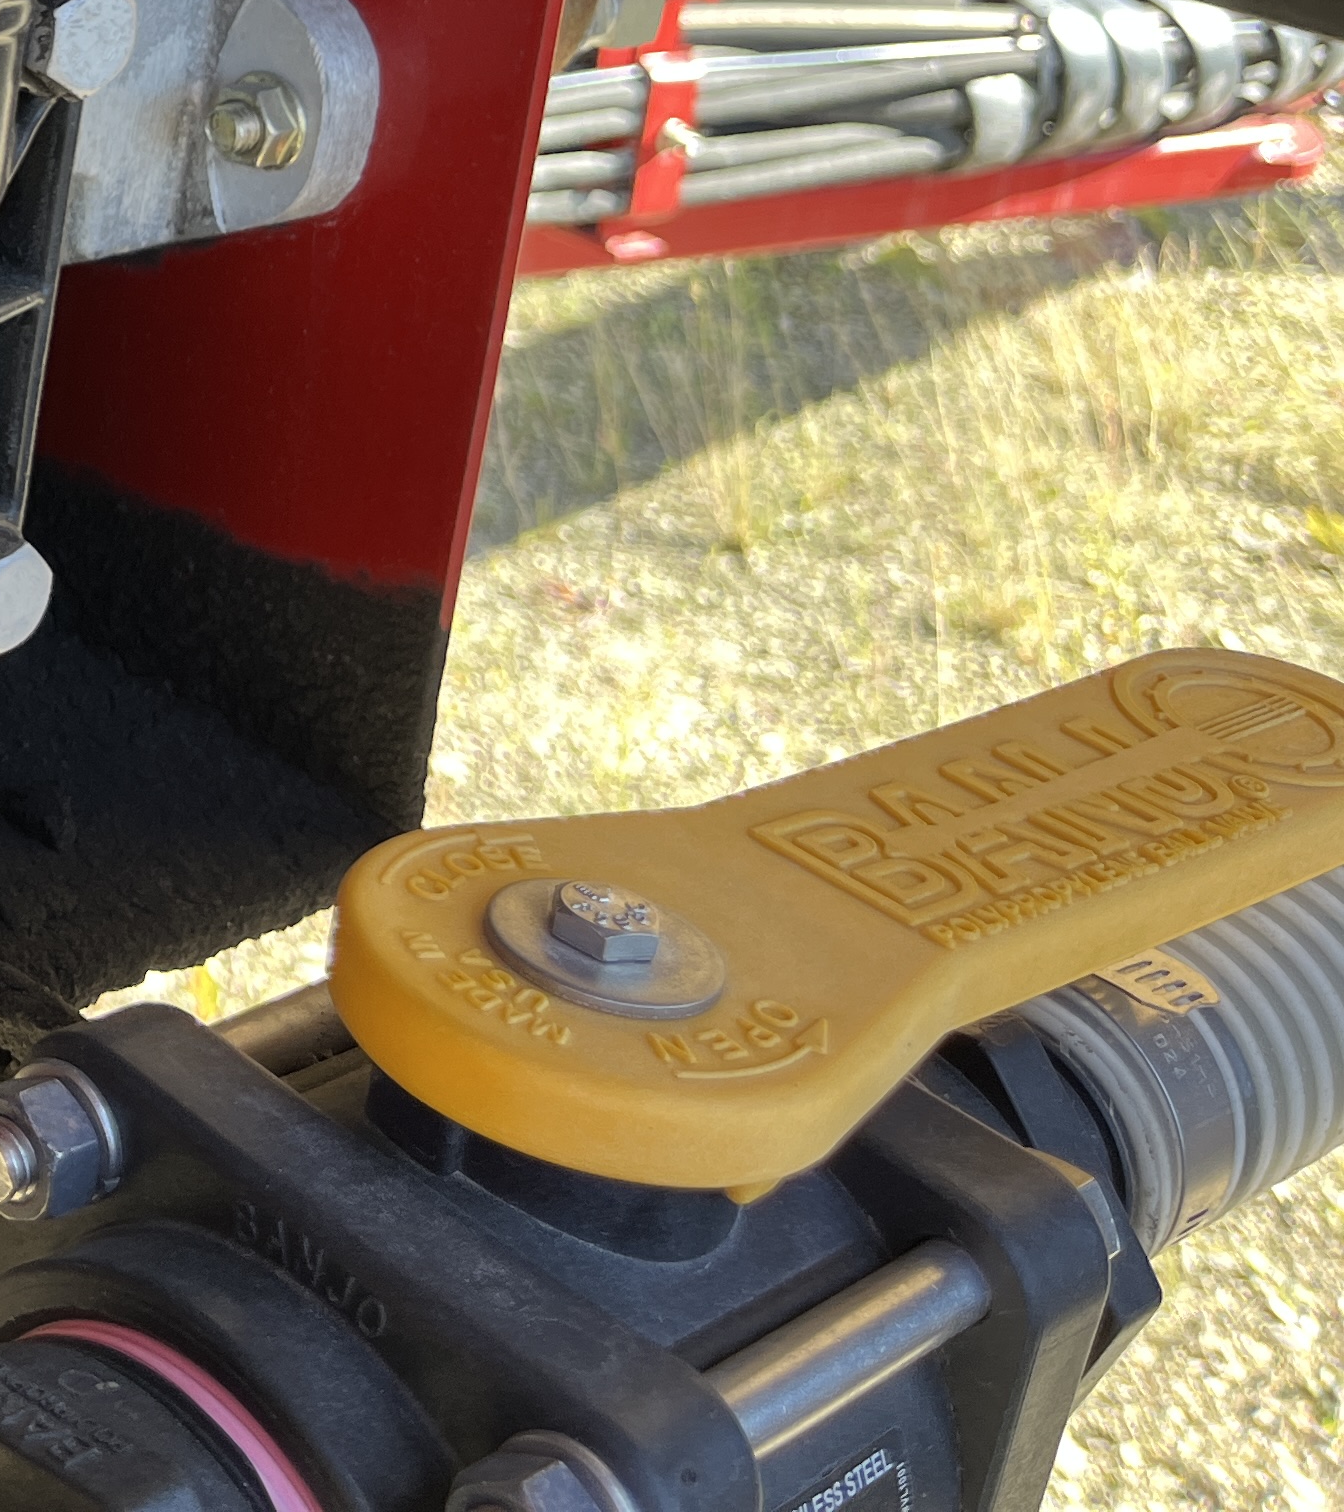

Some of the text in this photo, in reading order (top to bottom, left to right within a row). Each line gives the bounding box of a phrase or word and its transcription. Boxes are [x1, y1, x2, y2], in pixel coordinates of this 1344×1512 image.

[435, 967, 575, 1047] MADE
[456, 946, 553, 1015] USA
[646, 998, 801, 1066] OPEN
[843, 1448, 895, 1498] STEEL
